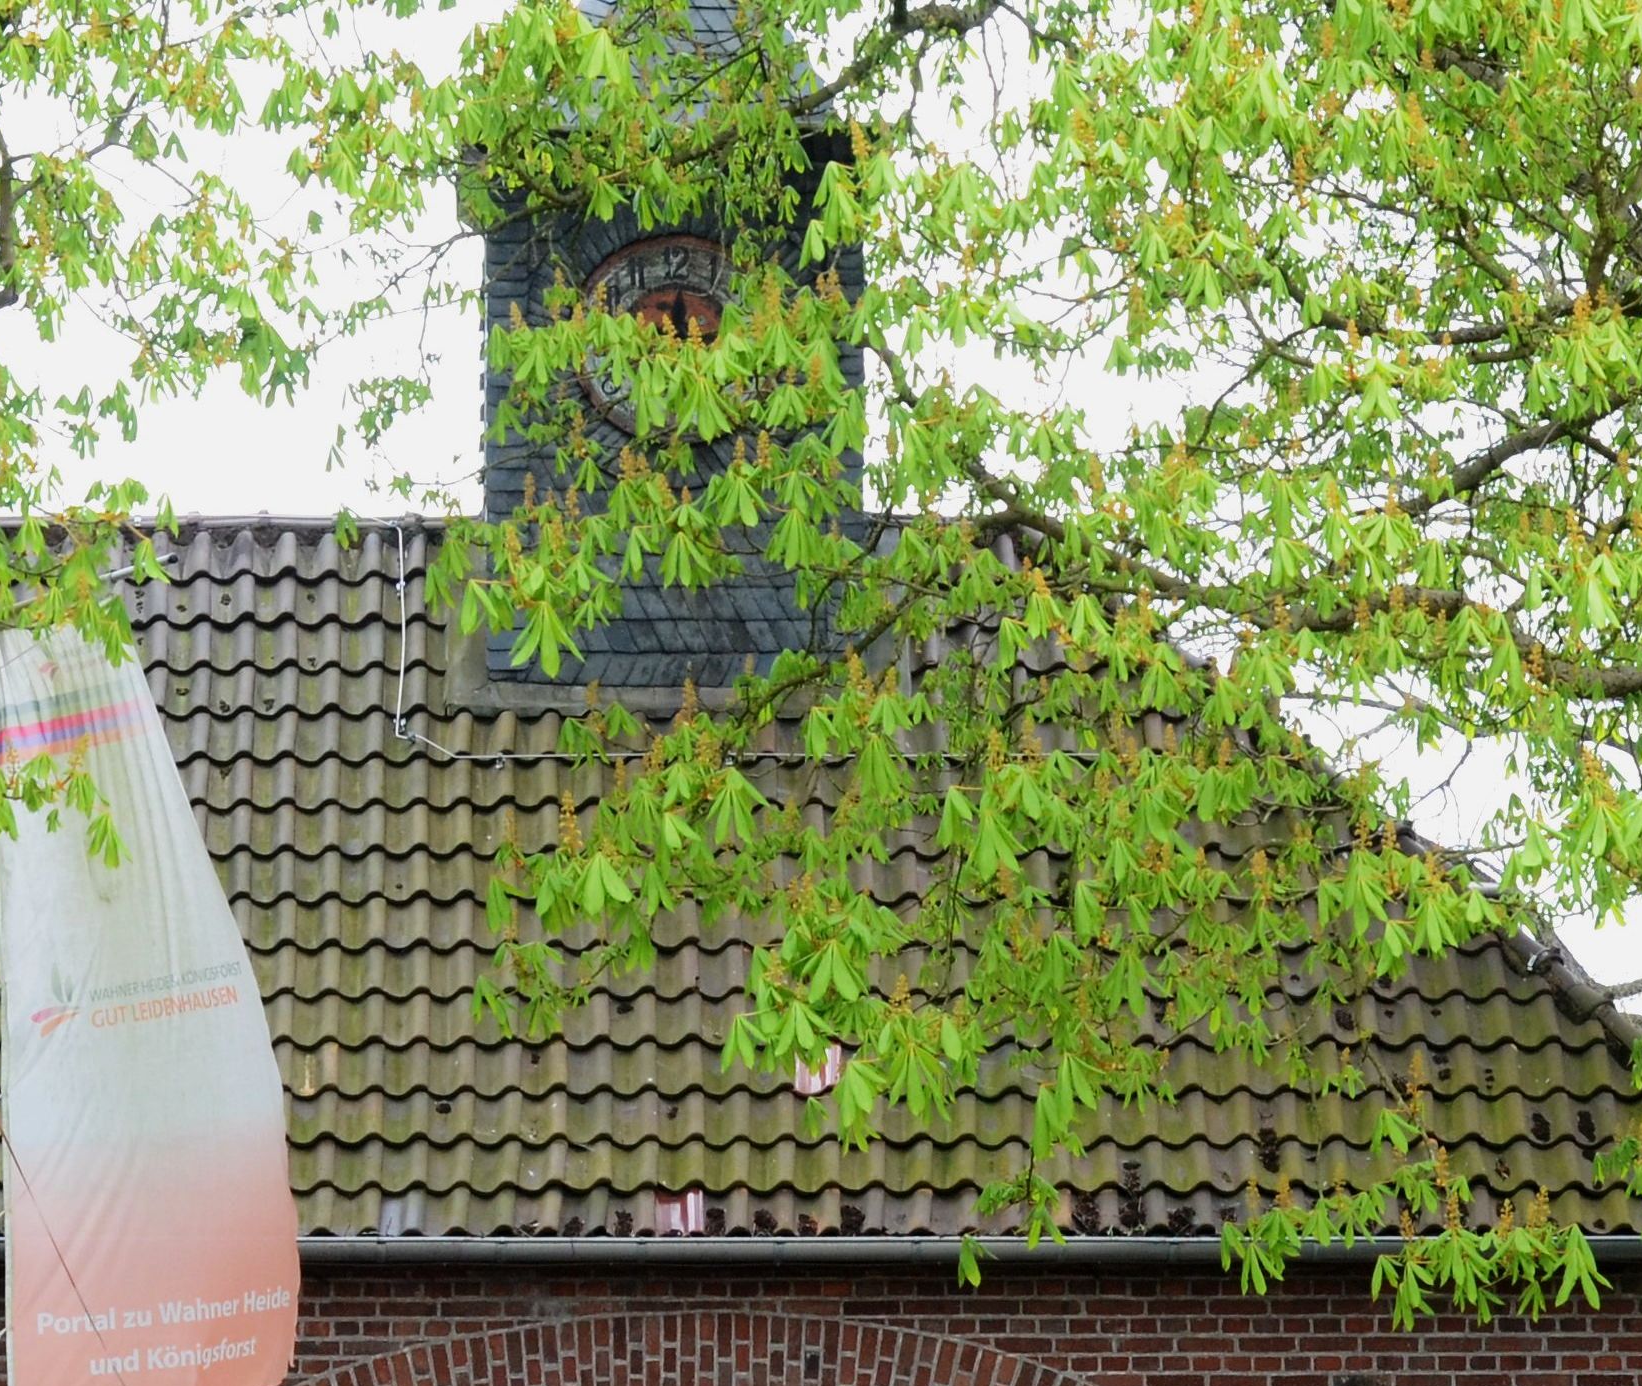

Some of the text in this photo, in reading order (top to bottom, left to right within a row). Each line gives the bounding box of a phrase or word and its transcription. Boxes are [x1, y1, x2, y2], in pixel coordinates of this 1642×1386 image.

[663, 246, 691, 280] 12
[91, 985, 238, 1028] GUT LEIDENHAUSEN
[36, 1285, 291, 1336] Portal zu Wahner Heide
[89, 1336, 257, 1377] und Königsforst
